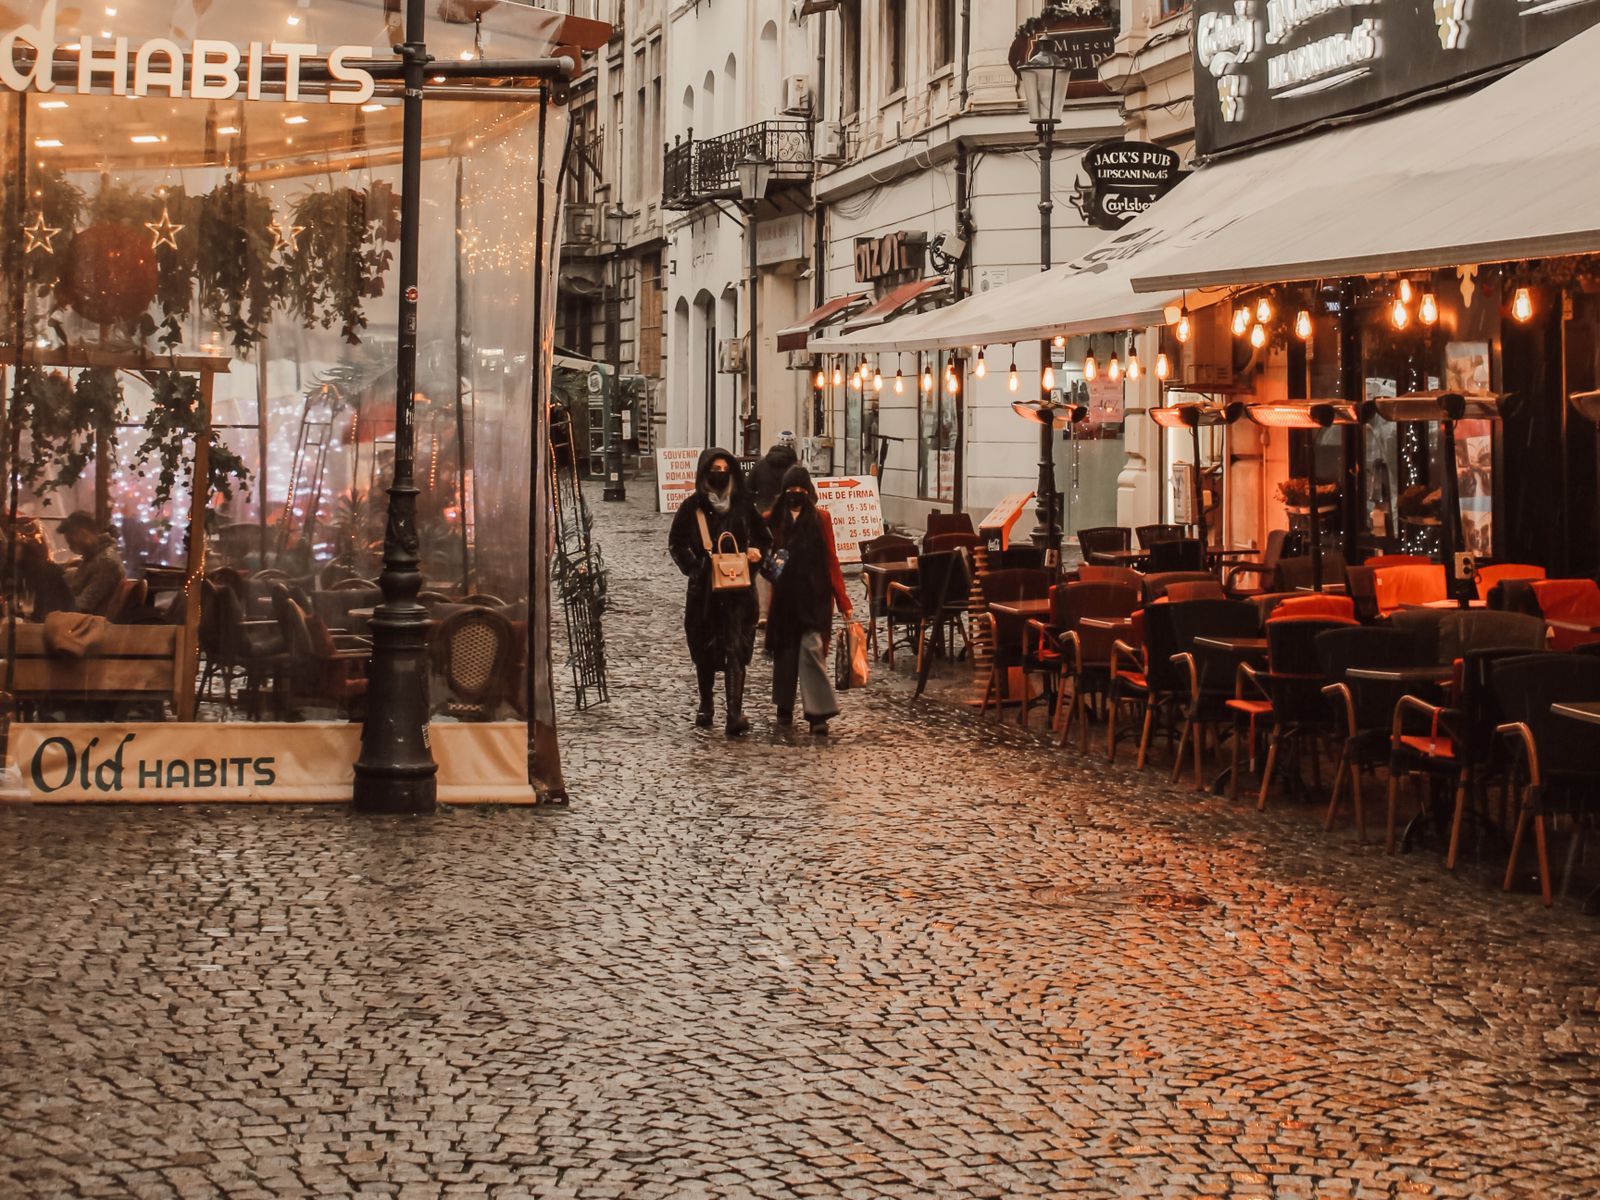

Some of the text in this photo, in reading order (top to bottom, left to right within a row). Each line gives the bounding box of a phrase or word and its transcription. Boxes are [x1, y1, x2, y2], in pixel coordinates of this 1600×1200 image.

[78, 35, 375, 104] HABITS
[1094, 151, 1171, 167] JACK'S PUB
[1098, 169, 1140, 179] LIPSCANI
[663, 449, 698, 460] SOUVENIR
[671, 461, 691, 470] FROM
[817, 489, 874, 500] INE DE FIRMA
[847, 503, 854, 511] 15
[860, 503, 867, 511] 35
[848, 516, 856, 525] 25
[861, 515, 869, 524] 55
[850, 529, 857, 538] 25
[862, 528, 870, 537] 55
[30, 733, 276, 792] Old HABITS
